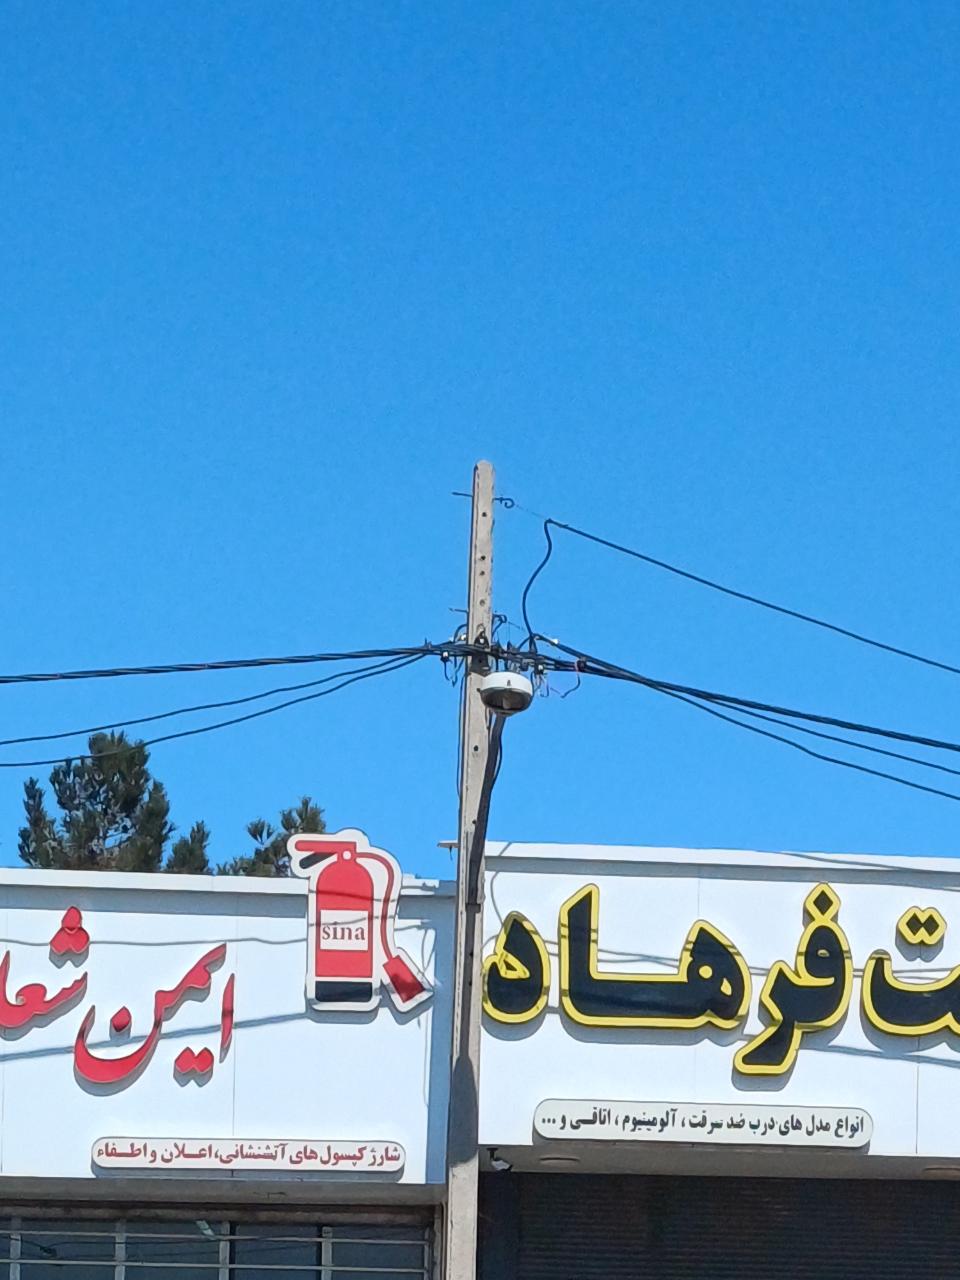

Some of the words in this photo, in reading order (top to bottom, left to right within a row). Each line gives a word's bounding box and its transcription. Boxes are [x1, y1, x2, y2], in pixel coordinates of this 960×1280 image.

[321, 920, 366, 941] sina
[481, 882, 854, 1076] فرهاد
[73, 941, 235, 1084] ایمن
[569, 1106, 611, 1130] اتاقی
[726, 1112, 746, 1129] ضد
[749, 1116, 775, 1136] درب
[778, 1113, 803, 1136] های
[805, 1113, 831, 1136] مدل
[834, 1115, 864, 1138] انواع
[97, 1141, 148, 1158] اطفاء
[148, 1149, 158, 1164] و
[160, 1141, 213, 1164] اعلان
[289, 1144, 318, 1165] های
[320, 1144, 367, 1167] کپسول
[367, 1145, 401, 1167] شارژ
